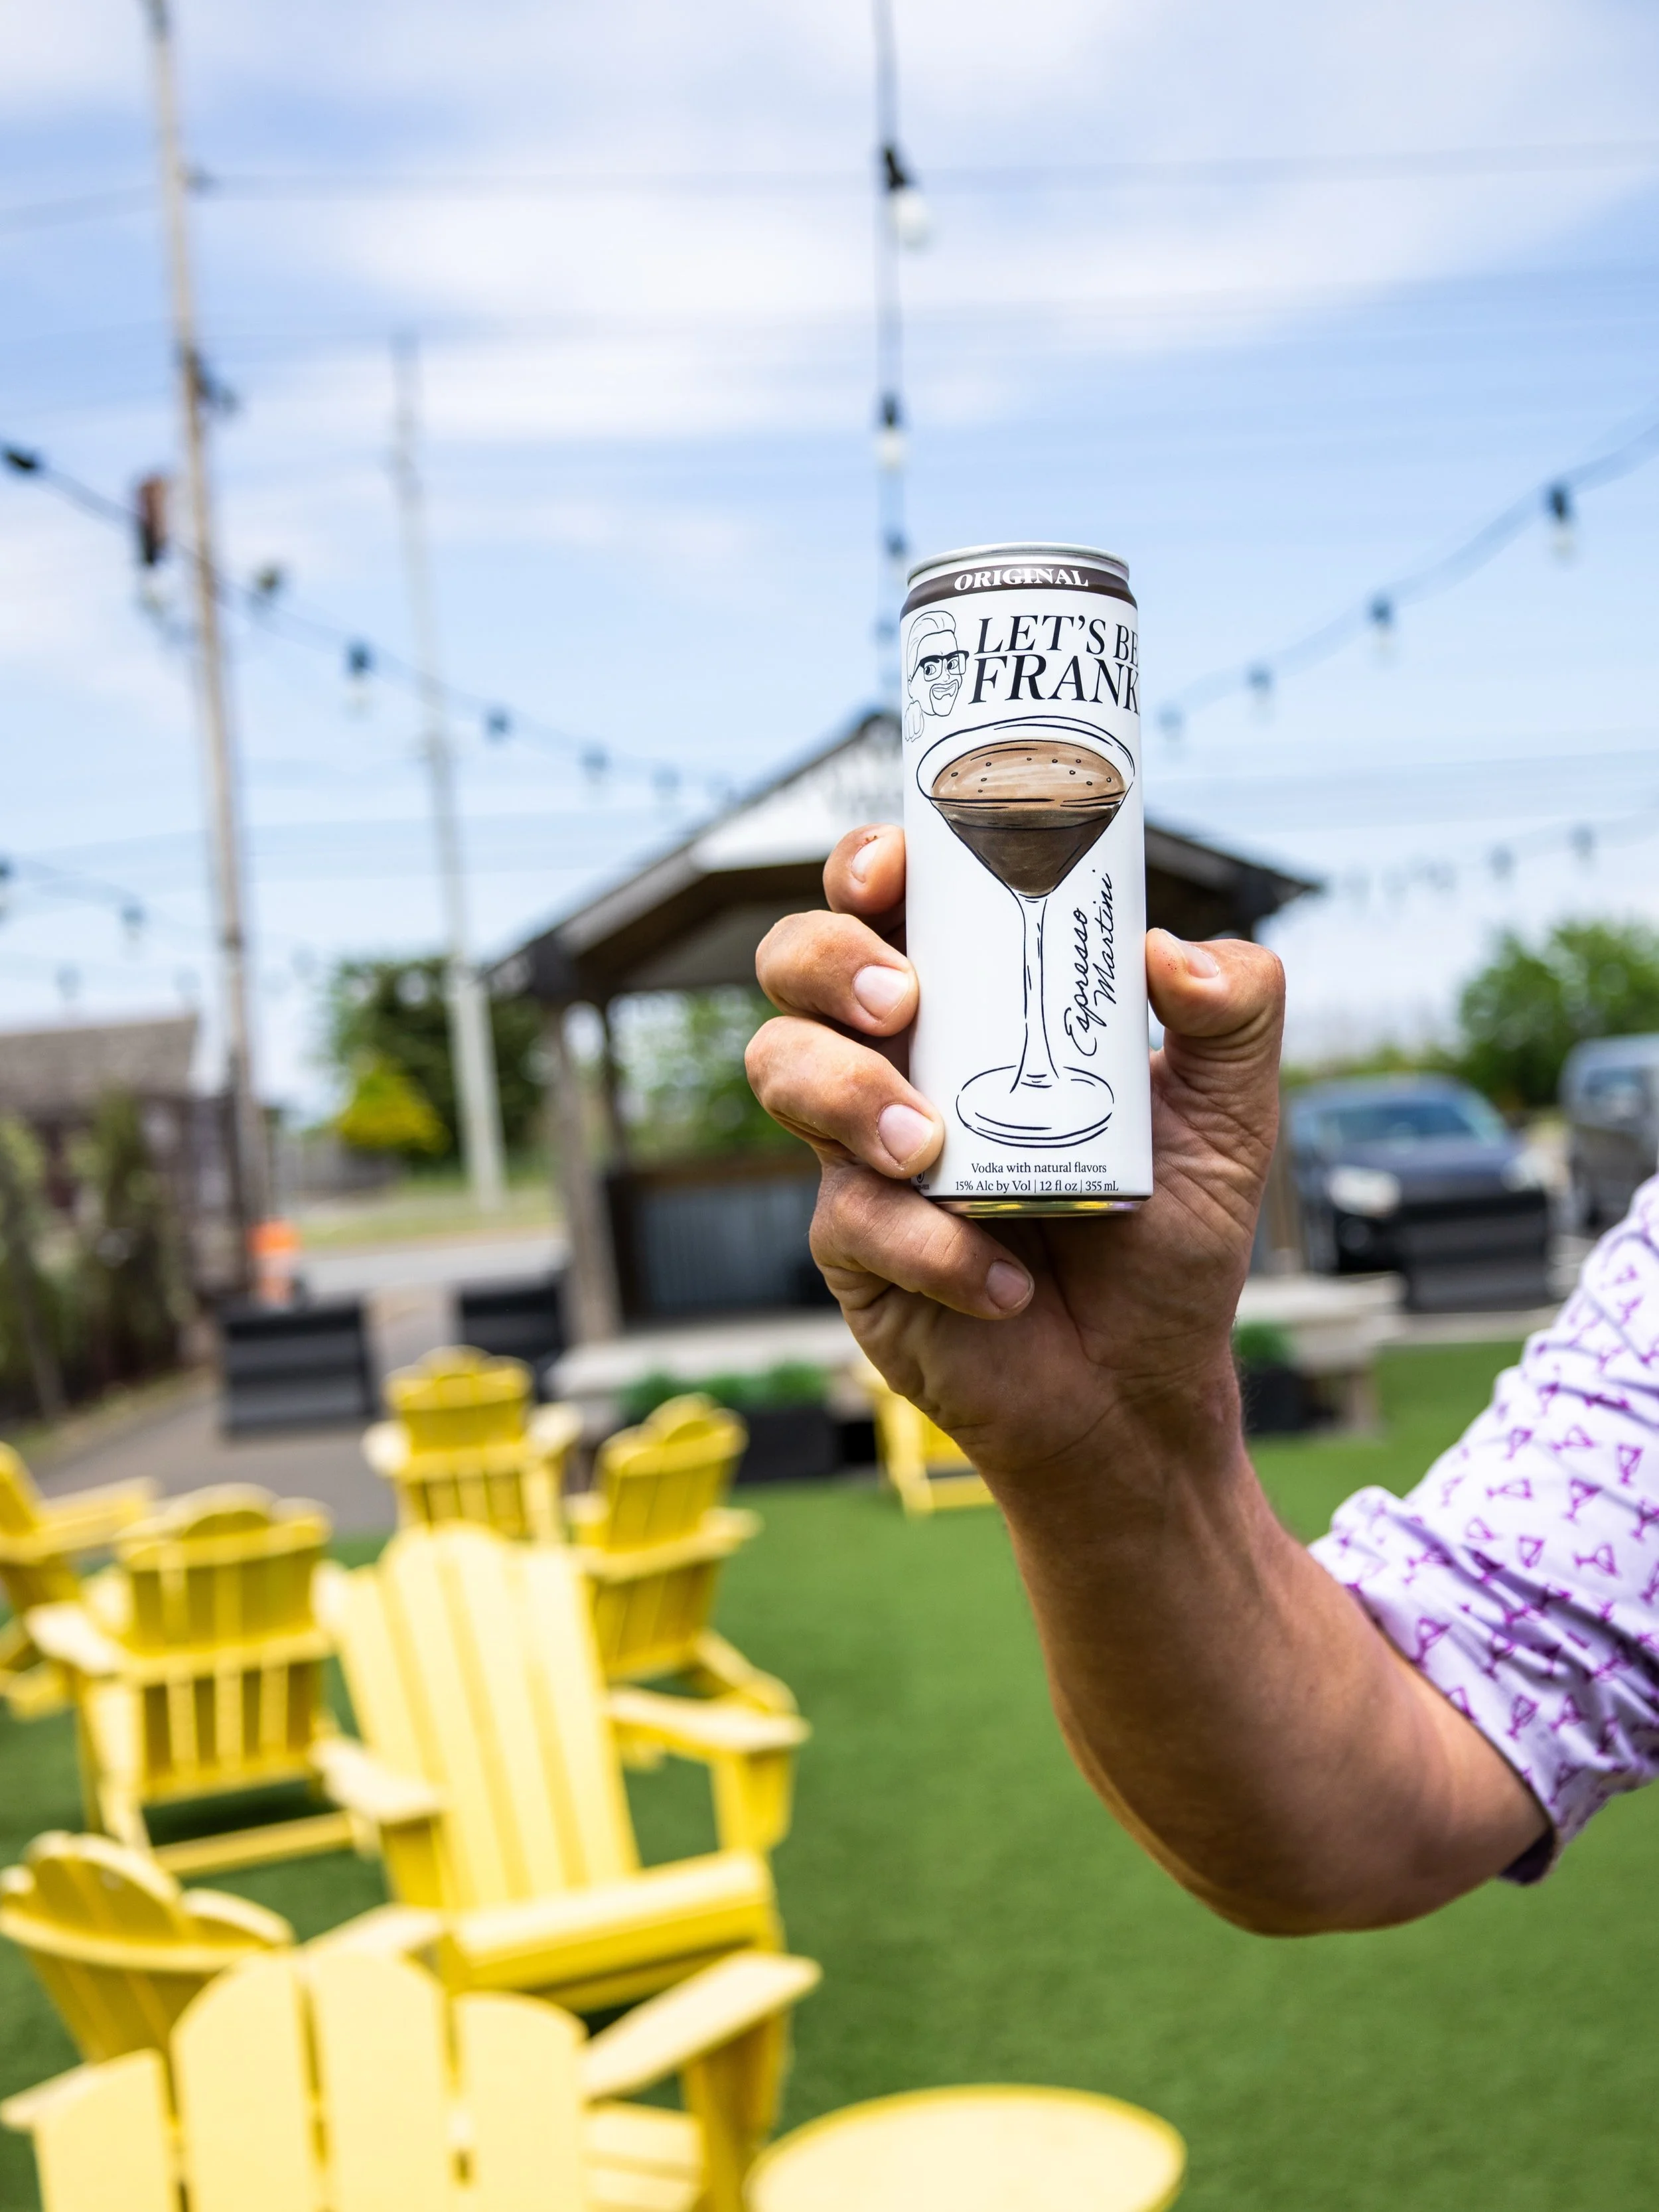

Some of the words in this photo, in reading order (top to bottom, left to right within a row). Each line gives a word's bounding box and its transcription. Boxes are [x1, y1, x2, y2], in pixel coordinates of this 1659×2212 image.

[954, 567, 1089, 591] ORIGINAL
[974, 615, 1106, 656] LET'S
[1112, 623, 1139, 668] BE
[968, 654, 1139, 717] FRANK
[1092, 869, 1117, 1005] Martini
[1064, 907, 1107, 1056] Espresso
[956, 1181, 974, 1191] 15%
[975, 1180, 994, 1191] Alc
[996, 1180, 1010, 1194] by
[1012, 1180, 1031, 1191] Vol
[1040, 1181, 1052, 1191] 12
[1054, 1179, 1062, 1191] fl
[1064, 1183, 1078, 1191] oz
[1085, 1180, 1102, 1191] 355
[1104, 1180, 1119, 1191] mL
[971, 1162, 1004, 1173] Vodka
[1006, 1161, 1031, 1173] with
[1034, 1161, 1072, 1173] natural
[1074, 1161, 1107, 1173] flavors
